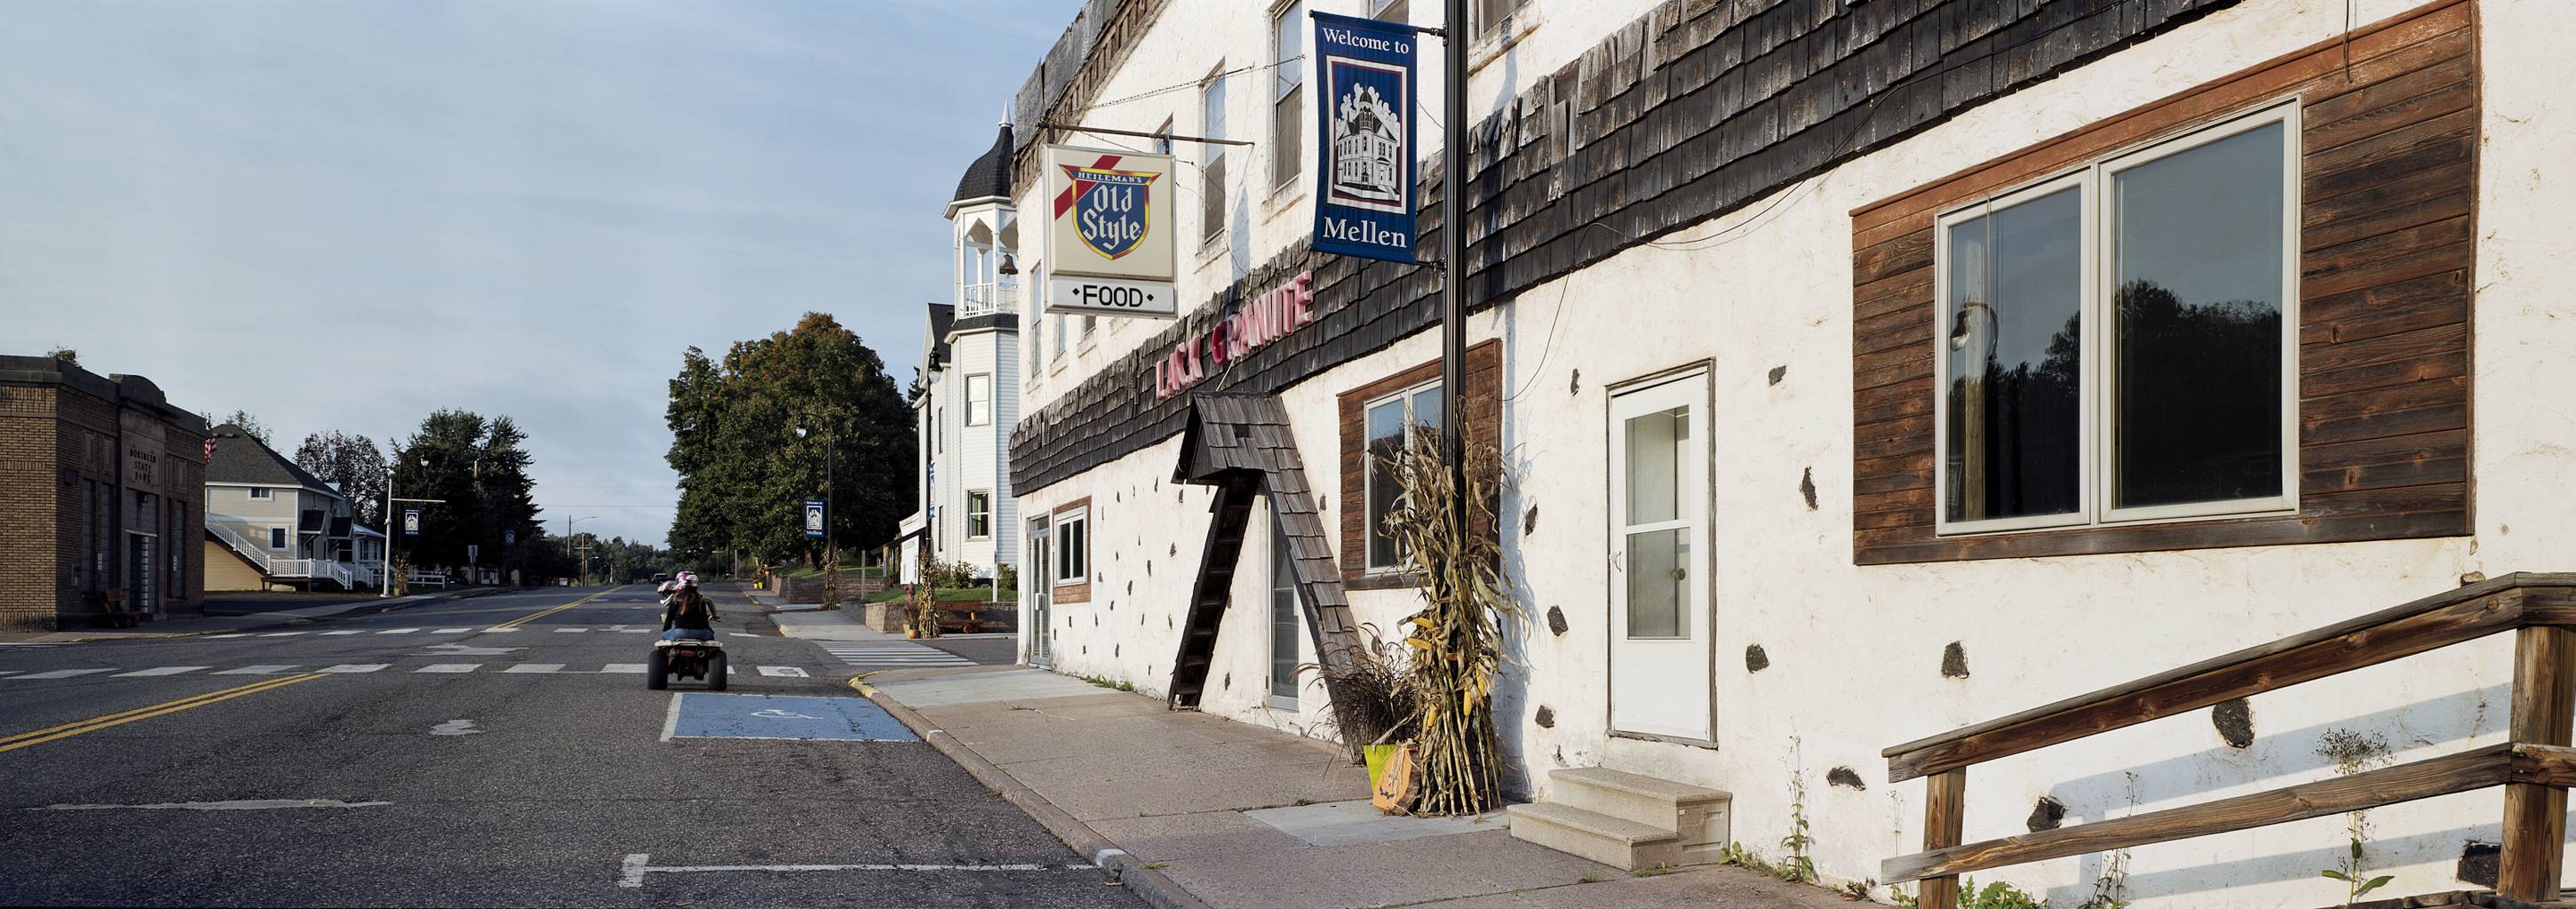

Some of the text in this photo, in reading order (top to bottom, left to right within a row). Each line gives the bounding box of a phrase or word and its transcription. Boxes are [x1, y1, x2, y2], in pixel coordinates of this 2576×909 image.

[1323, 28, 1410, 54] Welcome to
[1077, 171, 1142, 184] HEILEMAN'S
[1093, 185, 1133, 213] Old
[1082, 208, 1141, 251] Style
[1323, 217, 1408, 249] Mellen
[1083, 284, 1143, 307] FOOD
[1212, 270, 1314, 365] GRANITE
[134, 461, 151, 474] STATE
